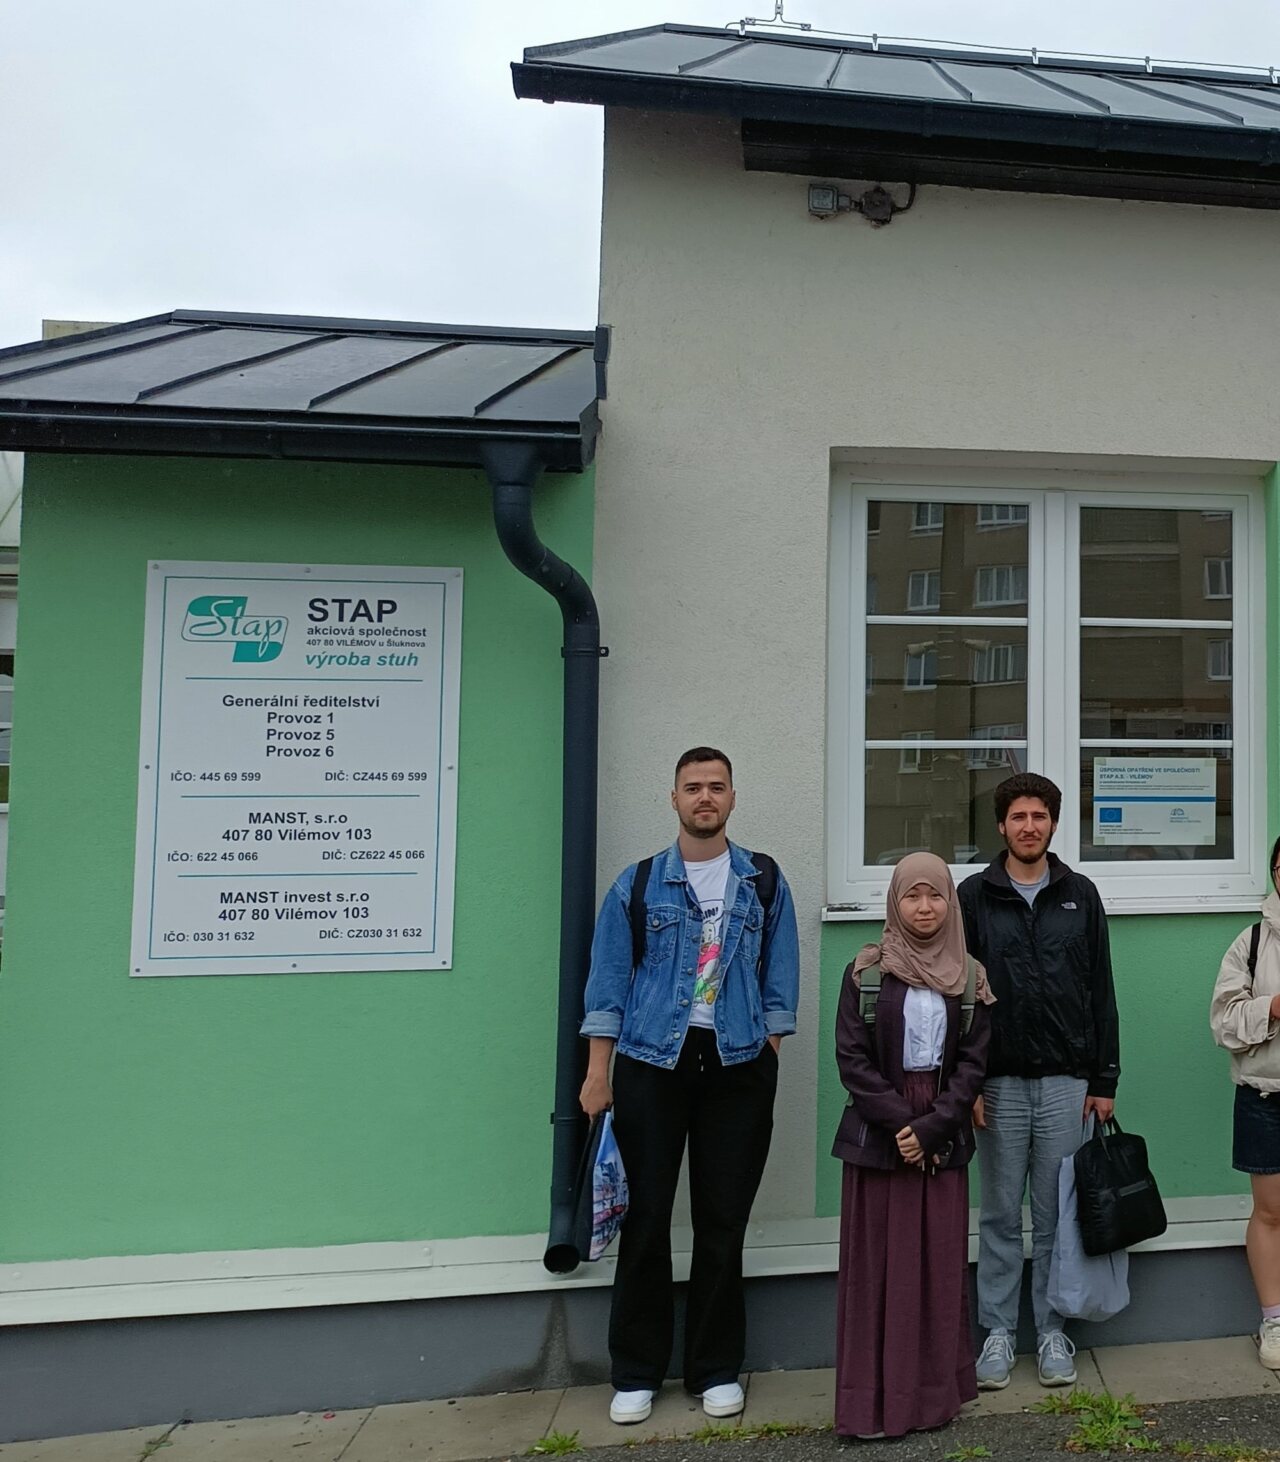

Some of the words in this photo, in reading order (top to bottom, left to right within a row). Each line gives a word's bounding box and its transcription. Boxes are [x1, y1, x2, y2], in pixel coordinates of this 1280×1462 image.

[307, 597, 398, 624] STAP
[188, 599, 283, 659] Stap
[306, 625, 355, 636] akciová
[358, 626, 427, 639] společnost
[305, 638, 322, 647] 407
[323, 638, 334, 647] 80
[335, 637, 377, 648] VILÉMOV
[386, 638, 426, 648] Šluknova
[305, 650, 371, 670] výroba
[376, 652, 419, 667] stuh
[222, 694, 299, 708] Generální
[303, 694, 381, 709] ředitelství
[267, 711, 322, 724] Provoz
[327, 711, 335, 724] 1
[266, 728, 322, 741] Provoz
[325, 728, 335, 741] 5
[266, 744, 321, 758] Provoz
[325, 745, 335, 758] 6
[170, 769, 196, 782] IČO:
[199, 772, 221, 782] 445
[223, 771, 238, 782] 69
[240, 771, 262, 782] 599
[324, 769, 349, 783] DIČ:
[352, 771, 389, 782] CZ445
[391, 771, 405, 782] 69
[407, 771, 428, 782] 599
[248, 811, 309, 826] MANST,
[314, 813, 348, 825] s.r.o
[221, 829, 250, 842] 407
[254, 828, 273, 842] 80
[277, 827, 341, 842] Vilémov
[345, 828, 372, 841] 103
[167, 850, 193, 863] IČO:
[196, 852, 218, 862] 622
[220, 851, 235, 862] 45
[237, 851, 259, 862] 066
[322, 848, 346, 861] DIČ:
[349, 850, 386, 860] CZ622
[388, 850, 403, 860] 45
[405, 849, 425, 860] 066
[219, 891, 280, 904] MANST
[284, 890, 332, 904] invest
[336, 891, 370, 903] s.r.o
[218, 908, 247, 922] 407
[251, 908, 270, 921] 80
[274, 907, 338, 920] Vilémov
[342, 906, 370, 919] 103
[163, 930, 190, 943] IČO:
[192, 932, 214, 942] 030
[216, 931, 230, 942] 31
[233, 931, 255, 941] 632
[318, 927, 343, 940] DIČ:
[346, 928, 383, 939] CZ030
[385, 928, 398, 938] 31
[402, 927, 423, 938] 632
